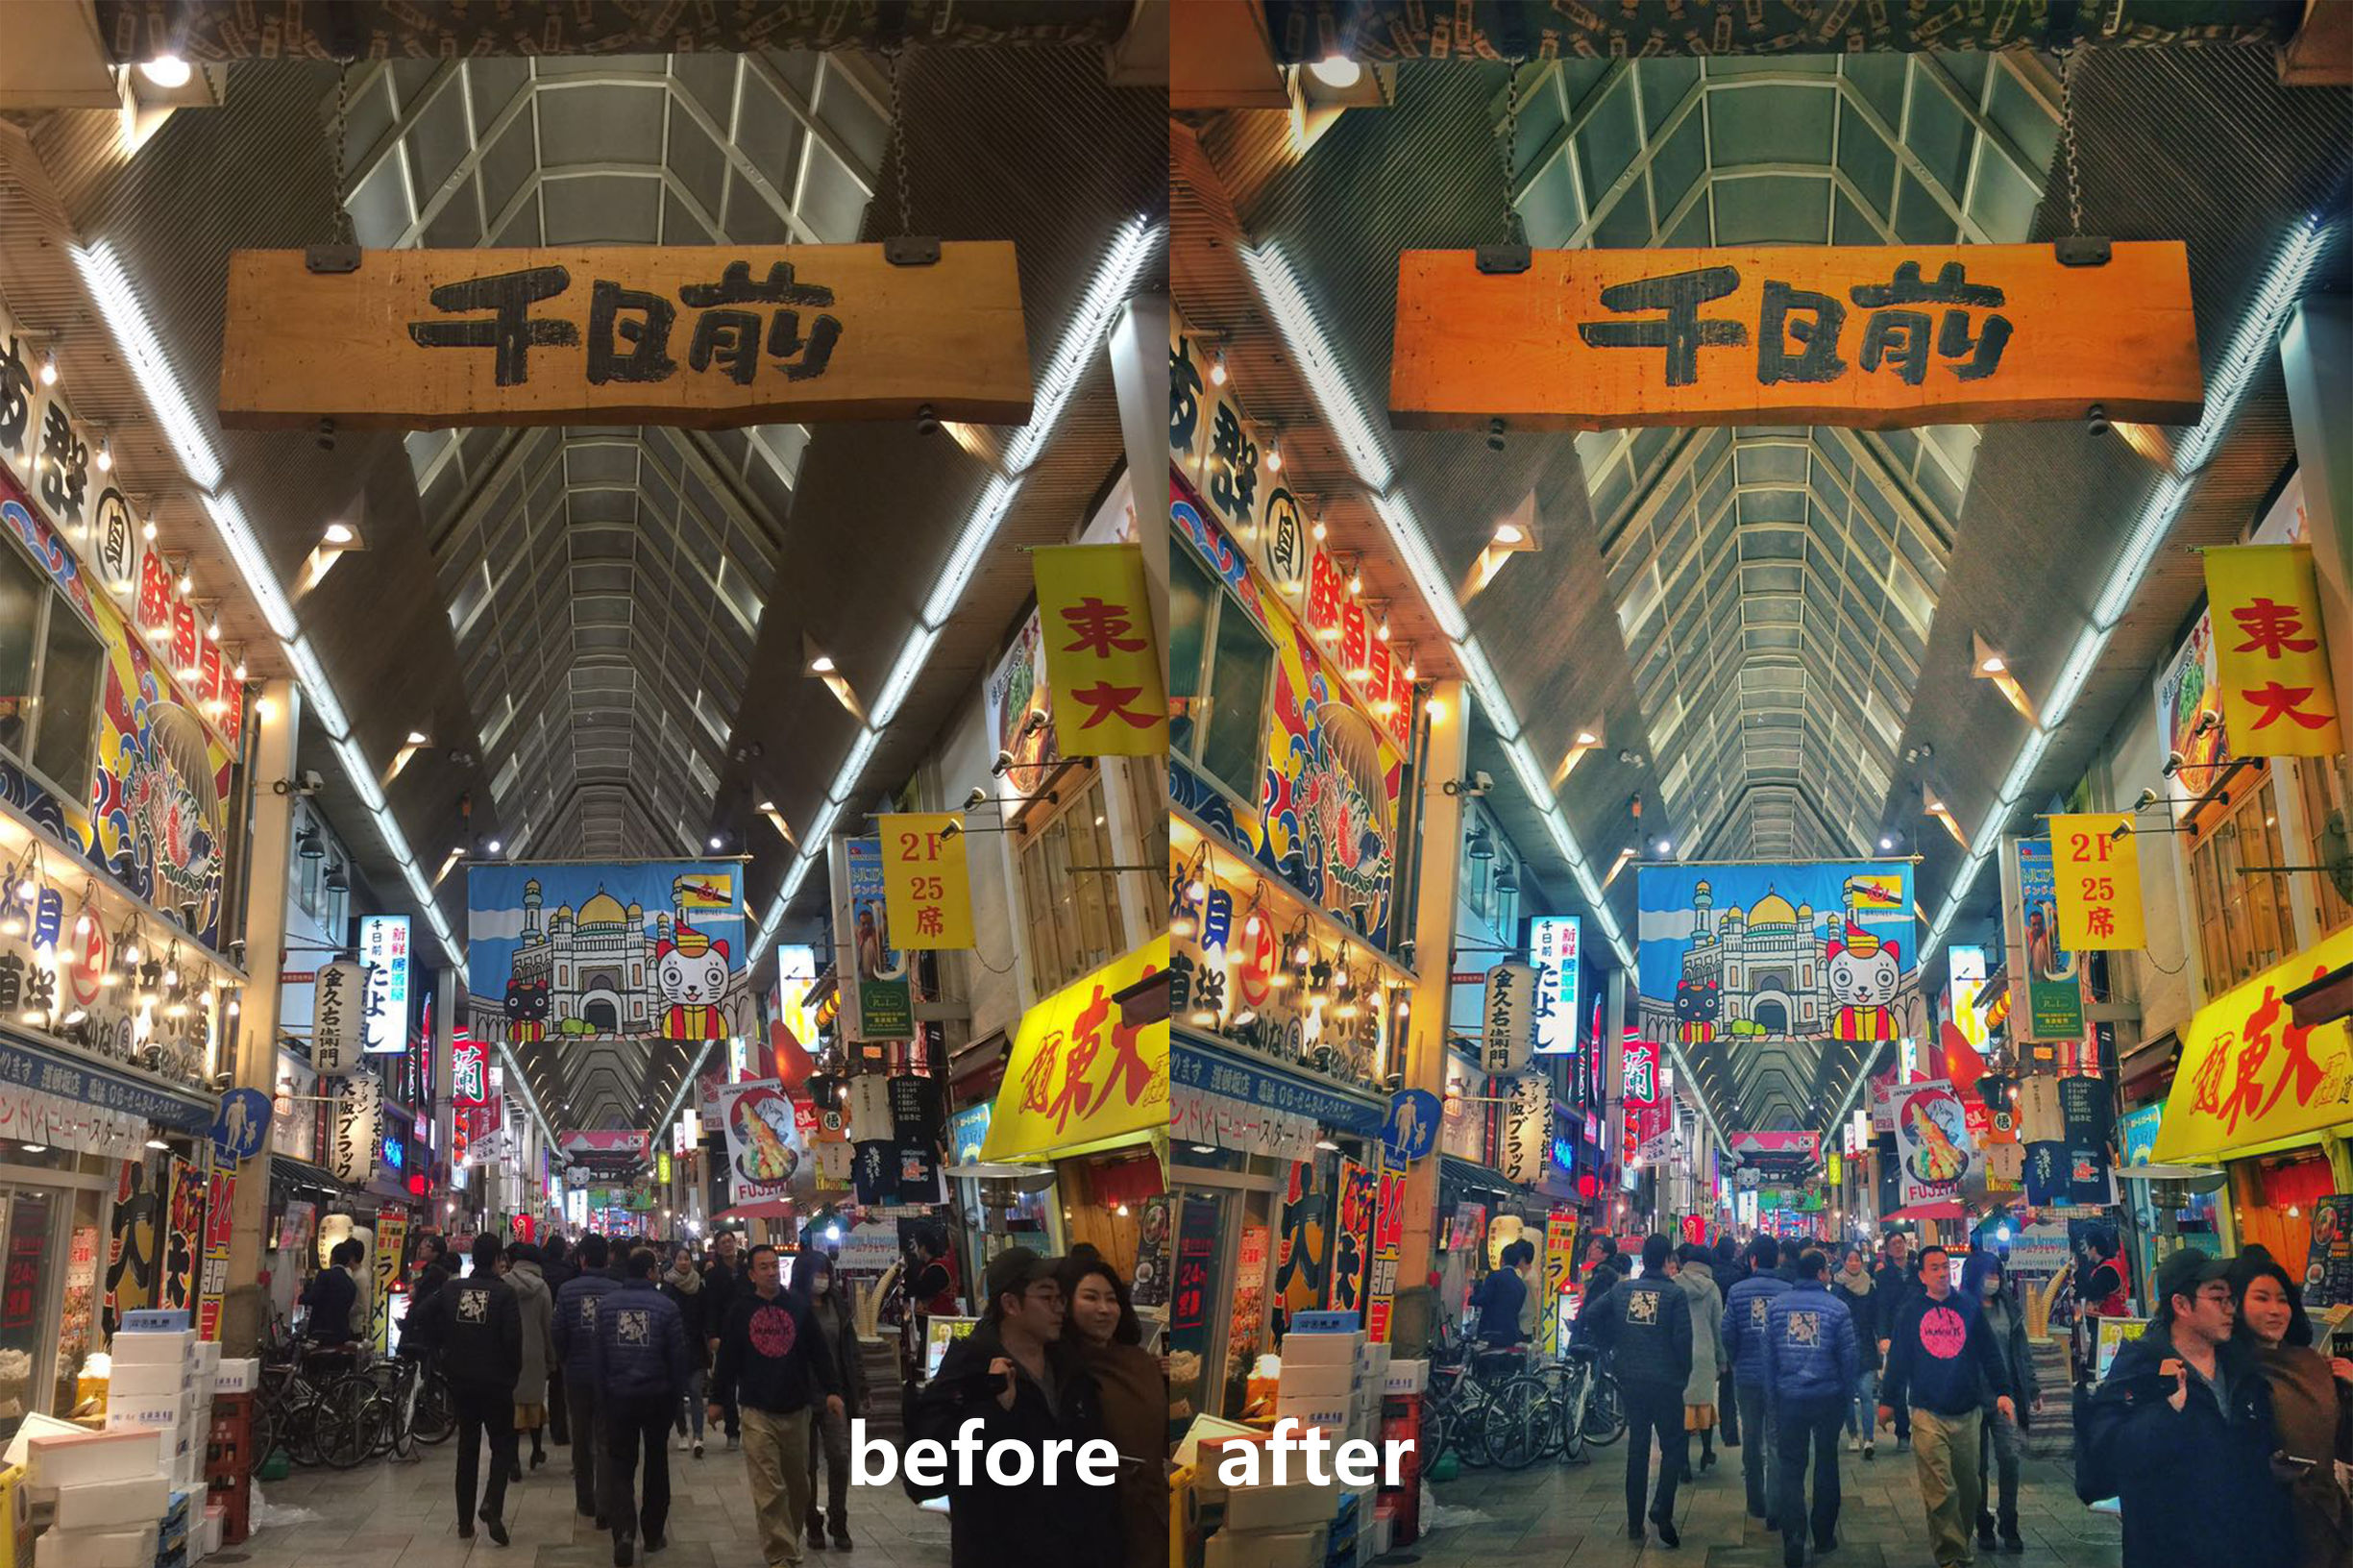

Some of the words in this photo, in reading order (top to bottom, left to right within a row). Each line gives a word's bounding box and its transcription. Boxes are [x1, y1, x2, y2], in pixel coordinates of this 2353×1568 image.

[407, 260, 843, 385] 千日前
[1578, 260, 2013, 386] 千日前
[1060, 597, 1164, 730] 東大
[2231, 598, 2336, 731] 東大
[899, 832, 944, 862] 2F
[2071, 833, 2116, 863] 2F
[911, 876, 944, 900] 25
[2082, 877, 2115, 901] 25
[372, 919, 382, 956] 千日前
[916, 905, 944, 939] 席
[1542, 920, 1553, 957] 千日前
[2087, 906, 2115, 940] 席
[319, 967, 345, 1068] 金久右衛門
[1489, 968, 1515, 1069] 金久右衛門
[356, 1076, 371, 1115] ラーメン
[1527, 1077, 1541, 1115] ラーメン
[335, 1080, 359, 1180] 大阪ブラック
[1506, 1081, 1530, 1181] 大阪ブラック
[206, 1171, 238, 1255] 24
[1375, 1172, 1408, 1256] 24
